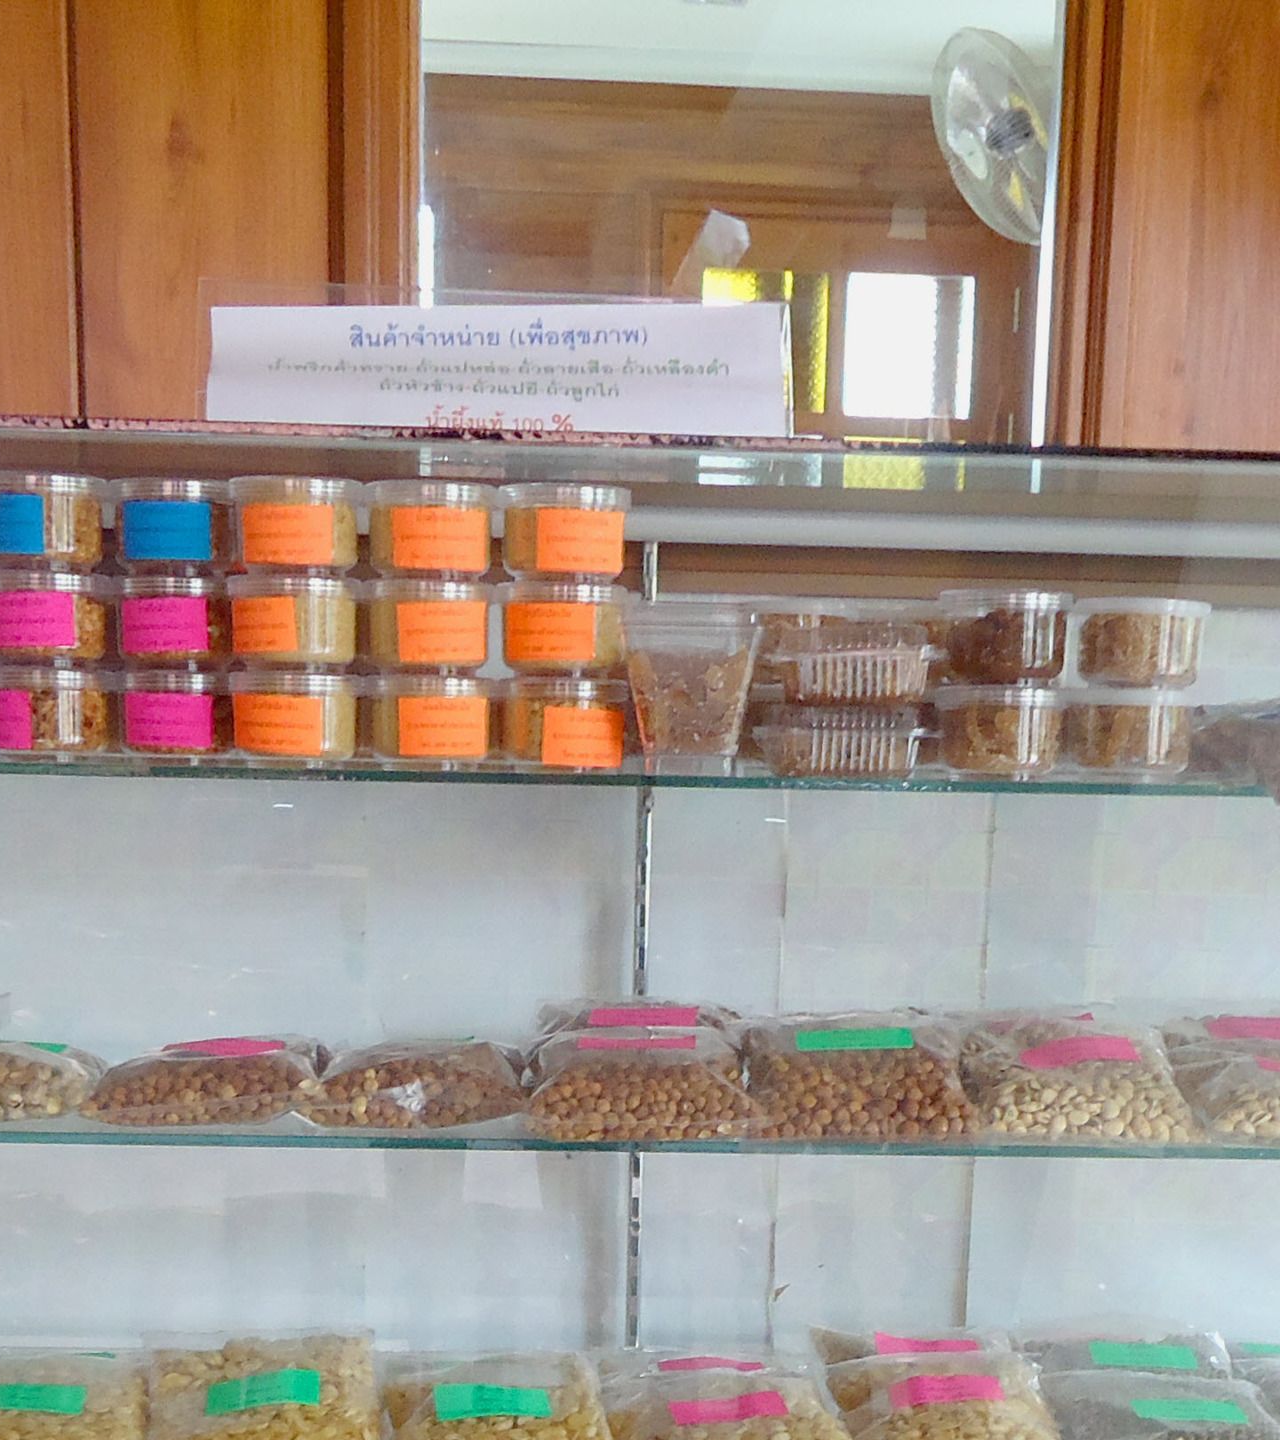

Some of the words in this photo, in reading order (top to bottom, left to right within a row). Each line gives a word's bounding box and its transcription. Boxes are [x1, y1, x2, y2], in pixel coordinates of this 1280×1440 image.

[349, 323, 500, 348] สินค้าจำหน่าย
[510, 317, 648, 351] (เพื่อสุขภาพ)
[512, 417, 544, 431] 100
[551, 413, 574, 432] %
